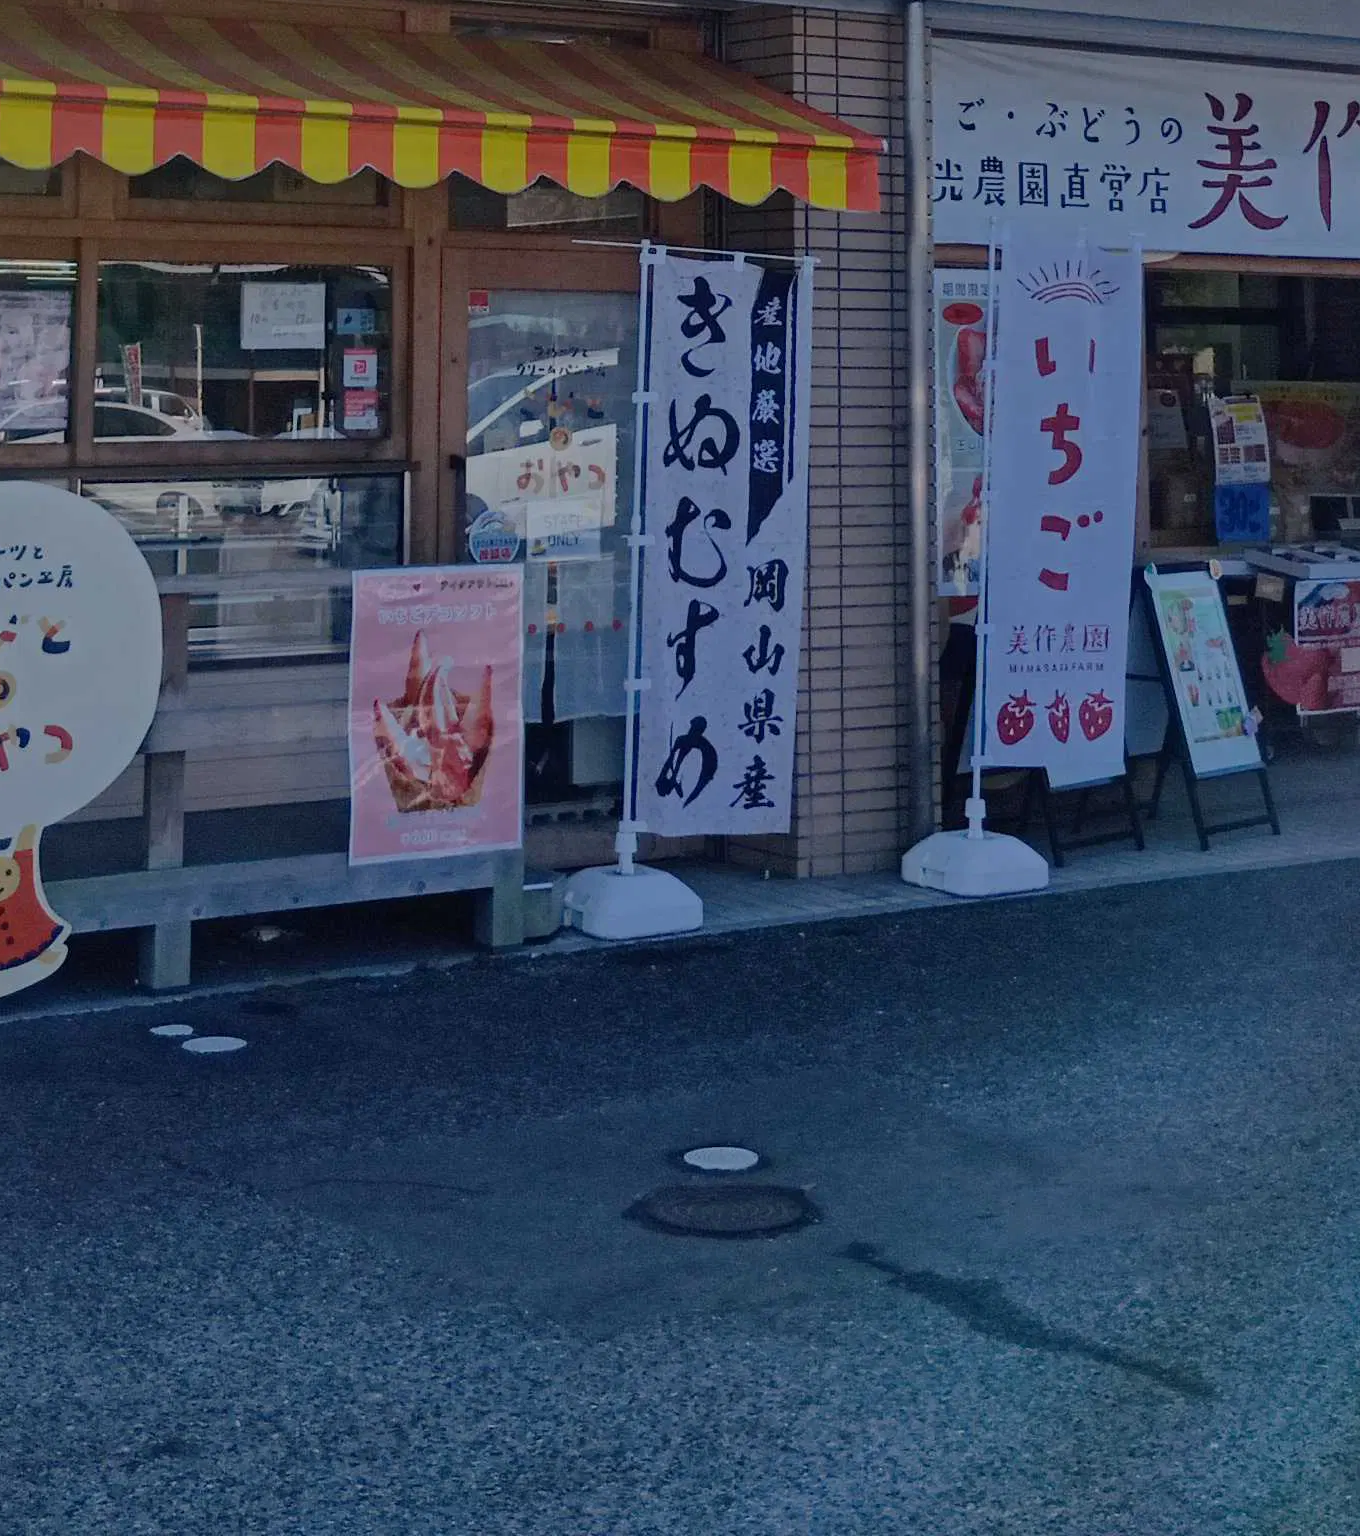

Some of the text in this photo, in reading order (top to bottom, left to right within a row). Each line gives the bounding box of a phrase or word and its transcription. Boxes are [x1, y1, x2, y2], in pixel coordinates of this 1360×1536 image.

[933, 156, 1170, 214] 光農園直営店
[517, 459, 606, 493] おやつ
[1034, 336, 1104, 592] いちご
[655, 276, 740, 807] きぬむすめ
[731, 558, 789, 809] 岡山県産
[1007, 623, 1111, 655] 美作農園
